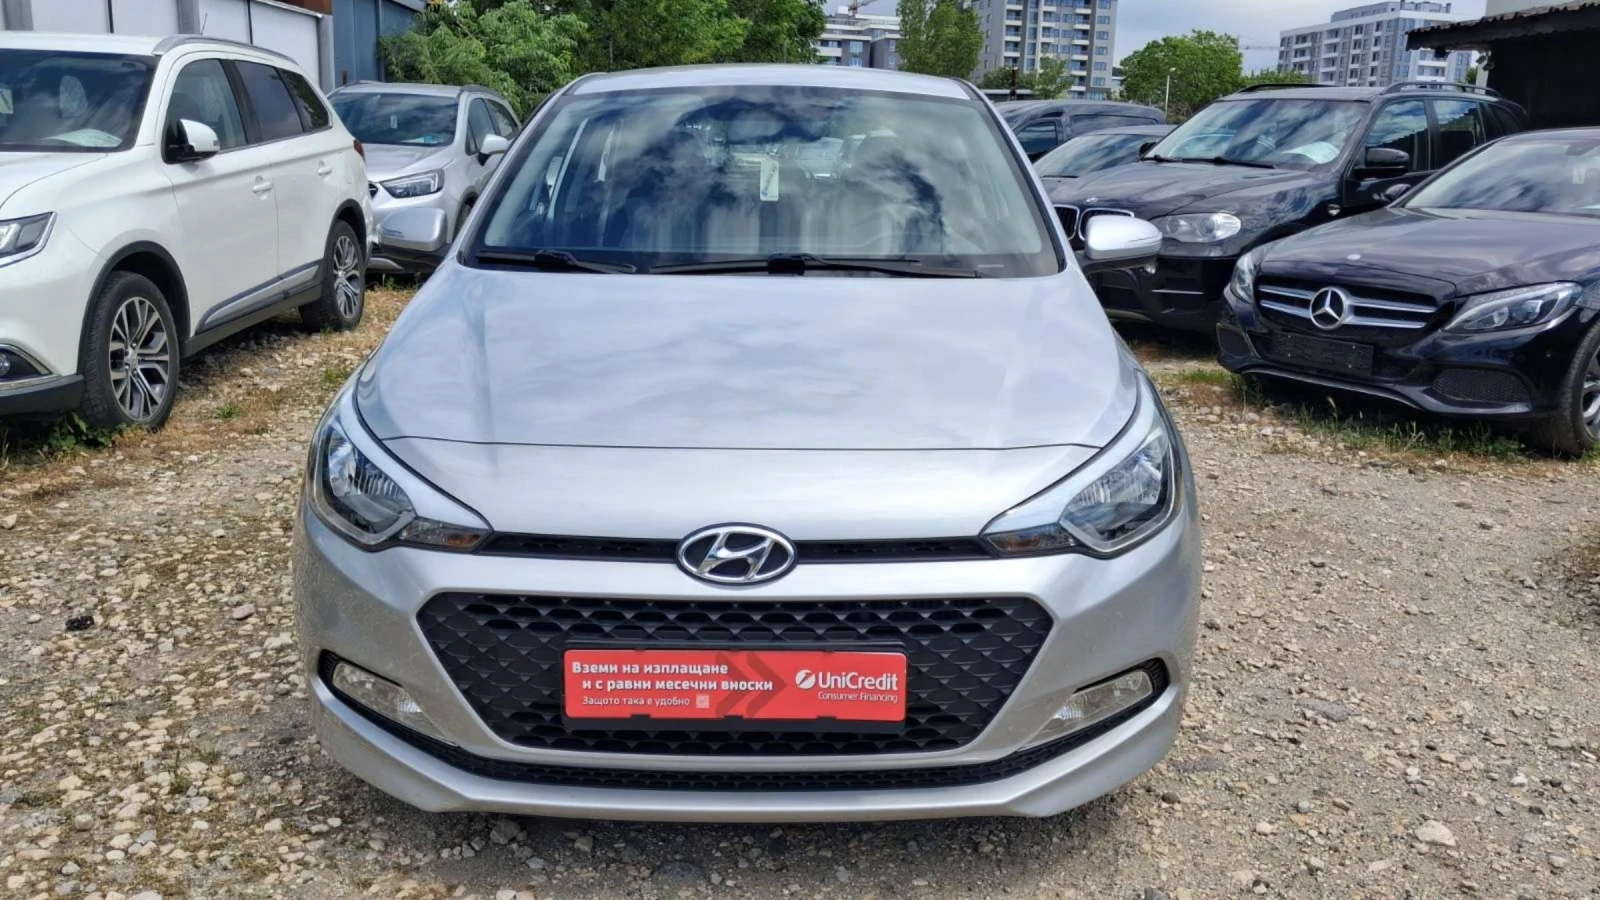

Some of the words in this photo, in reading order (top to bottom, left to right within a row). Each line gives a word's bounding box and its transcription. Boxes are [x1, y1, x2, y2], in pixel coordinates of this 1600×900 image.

[572, 662, 617, 674] Вземи
[623, 664, 639, 674] на
[644, 664, 728, 677] изплащане
[583, 680, 591, 690] и
[596, 680, 603, 690] с
[608, 680, 651, 692] равни
[656, 680, 717, 691] месечни
[721, 681, 773, 691] вноски
[819, 671, 898, 690] UniCredit
[583, 696, 619, 707] Защото
[623, 697, 644, 706] така
[647, 698, 653, 706] е
[655, 697, 690, 708] удобно
[818, 692, 858, 701] Consumer
[860, 692, 898, 703] Financing
